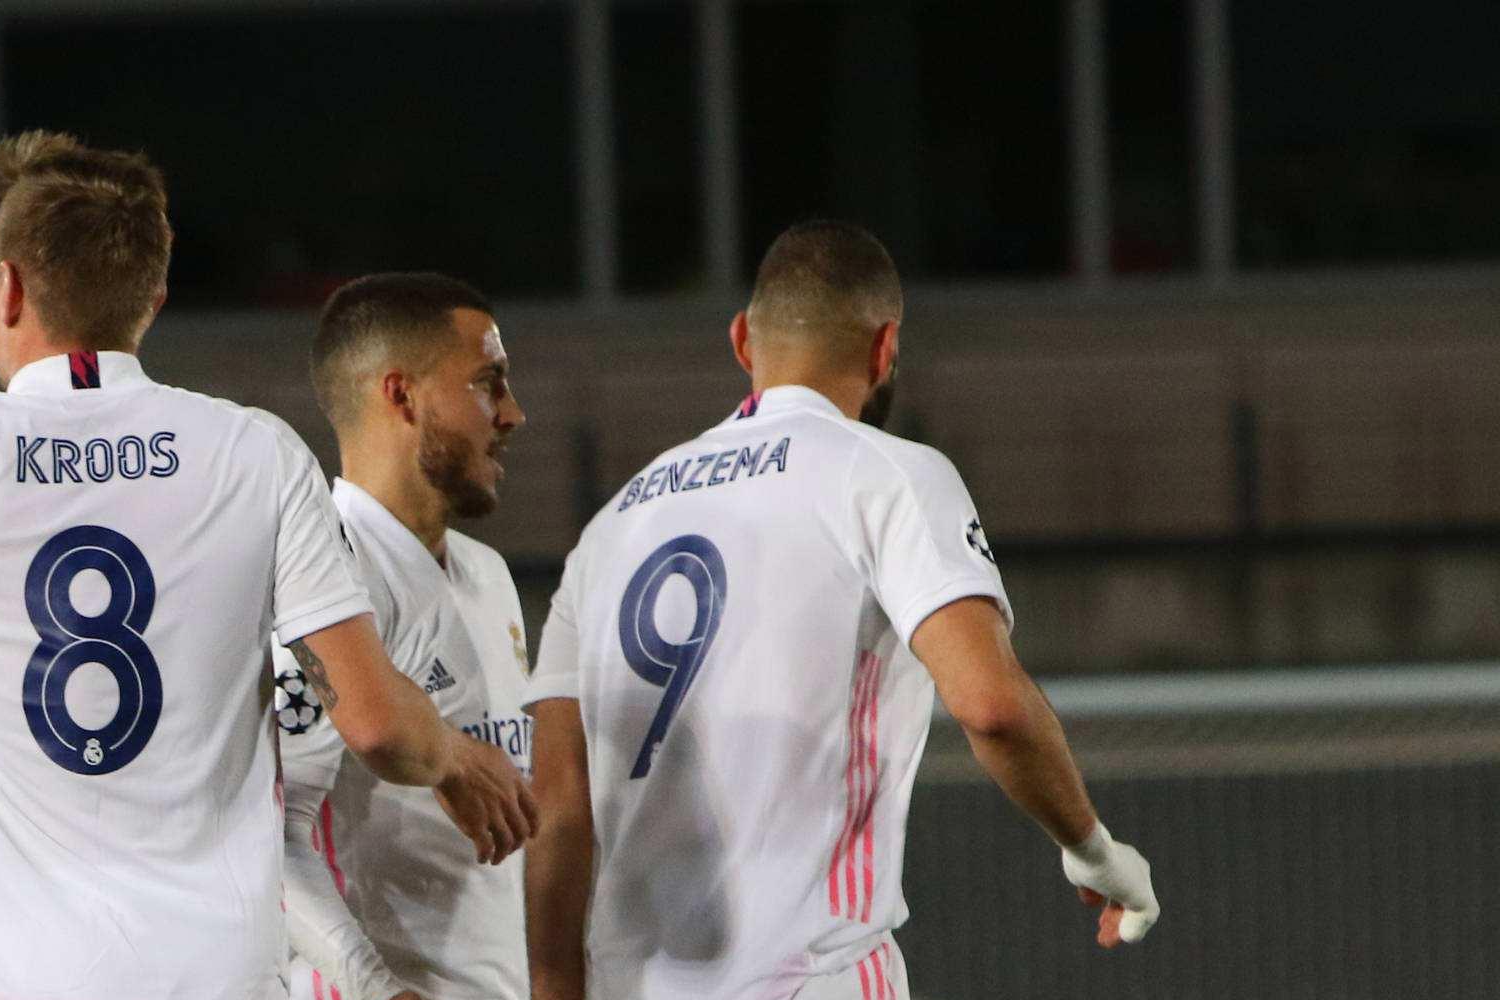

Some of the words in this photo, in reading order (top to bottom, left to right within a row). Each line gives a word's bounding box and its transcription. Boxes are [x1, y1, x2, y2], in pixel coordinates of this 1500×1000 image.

[16, 432, 180, 484] KROOS
[618, 437, 791, 512] BENZEMA
[22, 525, 163, 776] 8
[618, 534, 728, 780] 9
